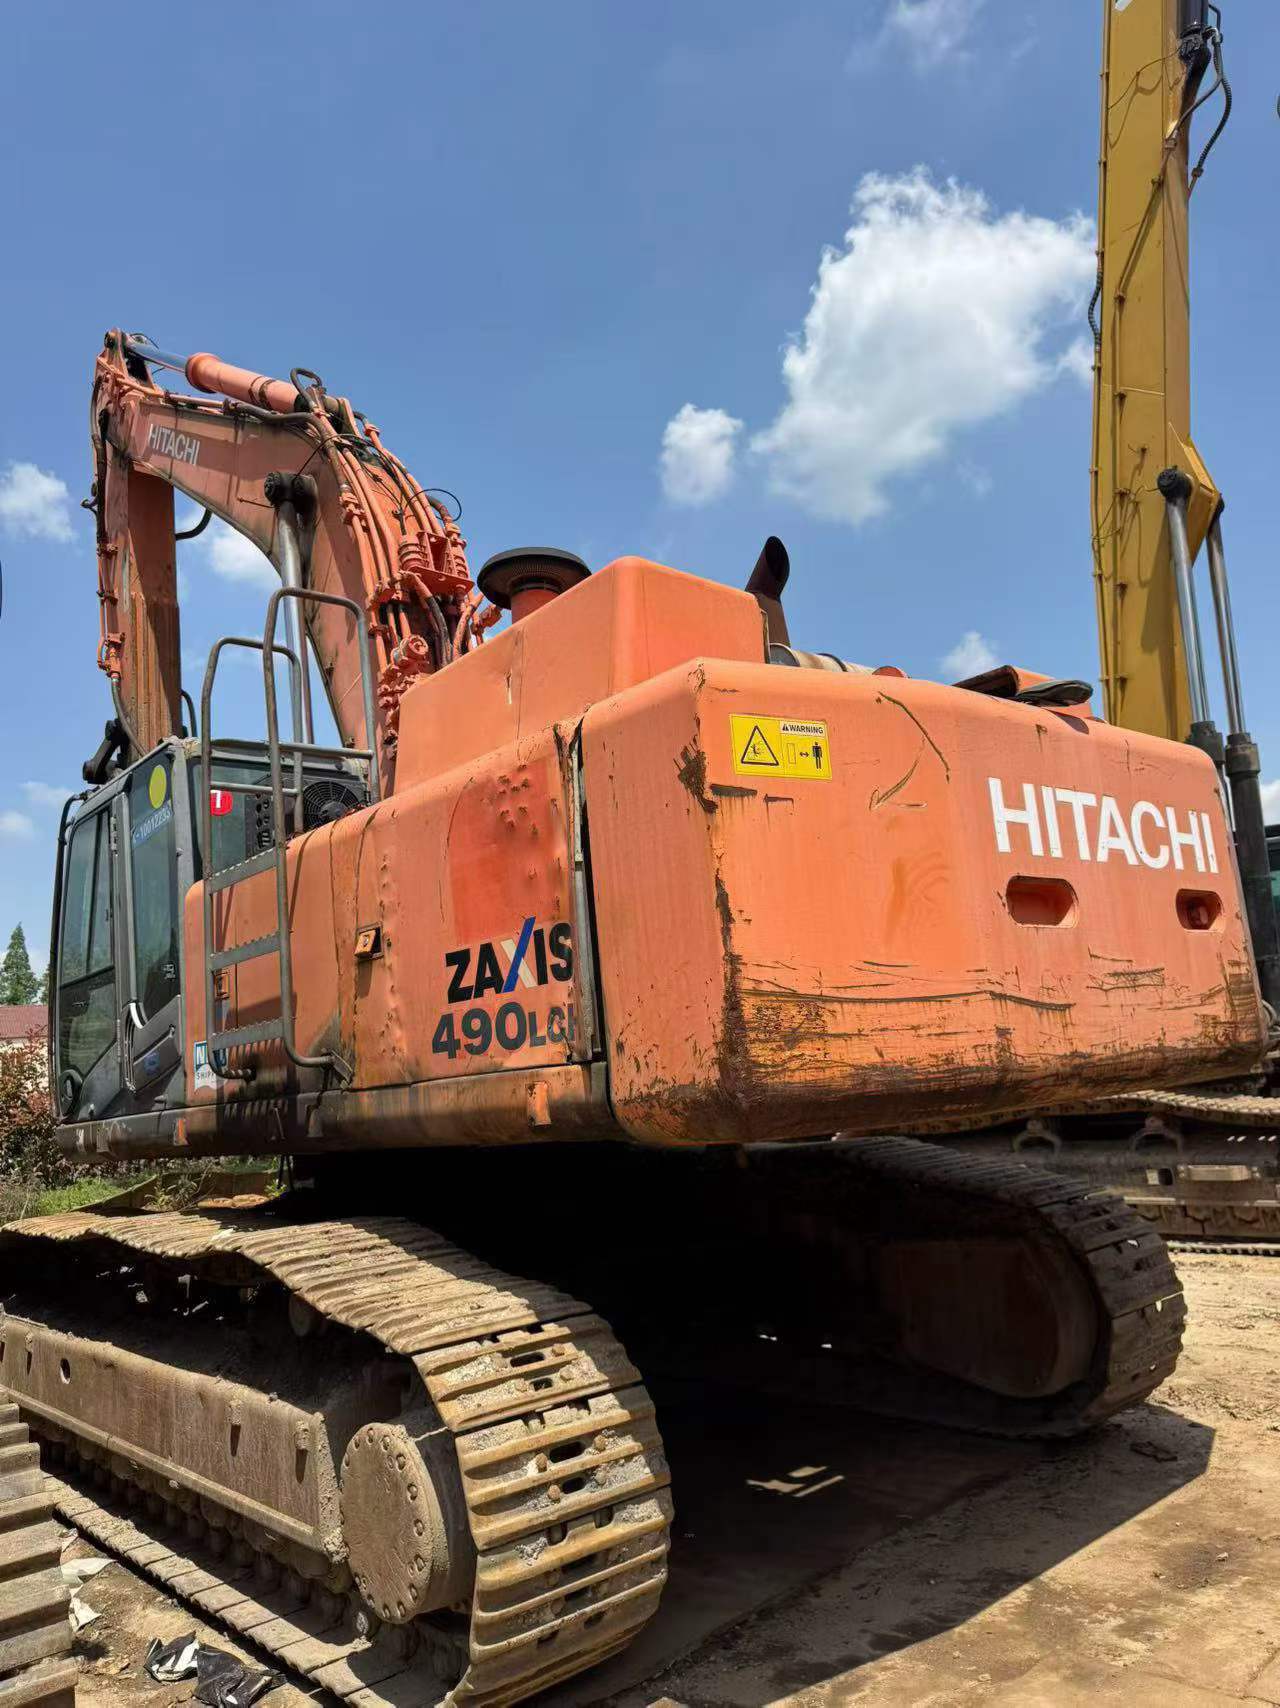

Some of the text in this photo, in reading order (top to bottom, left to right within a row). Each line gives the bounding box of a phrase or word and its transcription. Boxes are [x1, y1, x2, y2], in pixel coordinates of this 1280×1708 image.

[148, 423, 200, 466] HITACHI
[789, 724, 824, 735] WARNING
[988, 777, 1219, 874] HITACHI
[445, 915, 574, 1004] ZAXIS
